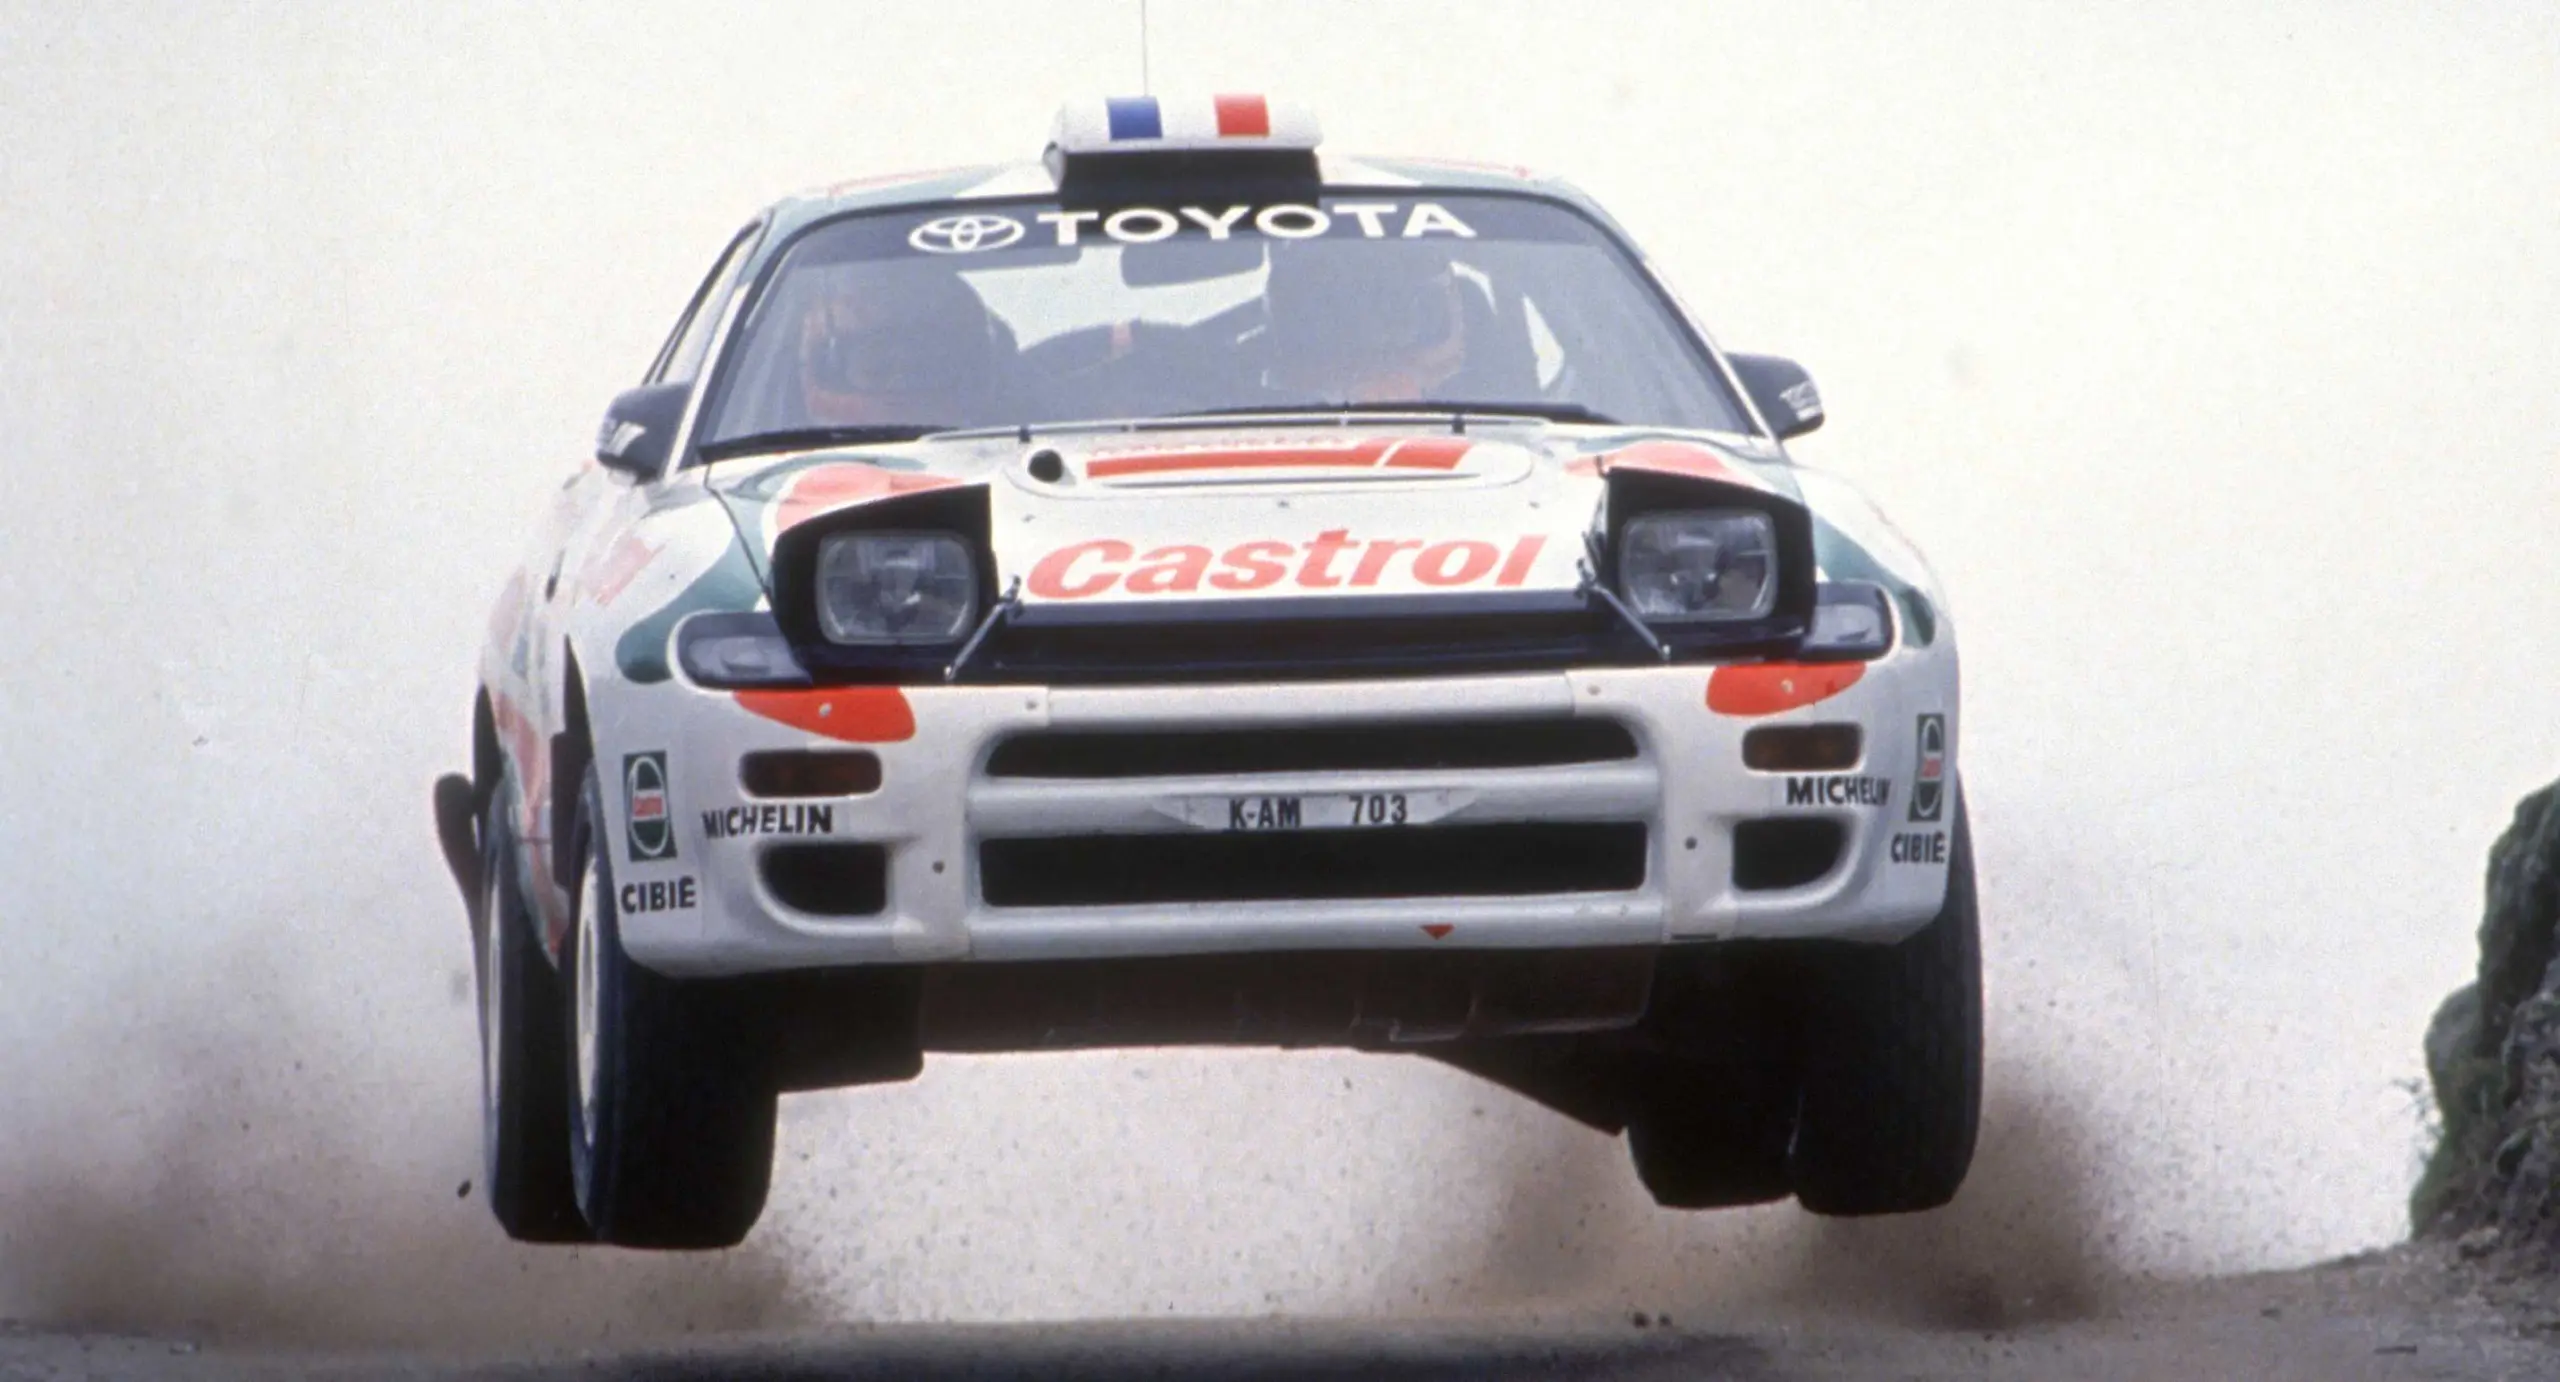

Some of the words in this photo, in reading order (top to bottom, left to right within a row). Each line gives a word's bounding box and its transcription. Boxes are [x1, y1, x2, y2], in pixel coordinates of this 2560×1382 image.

[1037, 204, 1476, 245] TOYOTA
[1027, 530, 1547, 598] Castrol
[1786, 776, 1892, 806] MICHELIN
[701, 805, 833, 838] MICHELIN
[1229, 797, 1301, 829] K-AM
[1349, 794, 1407, 824] 703
